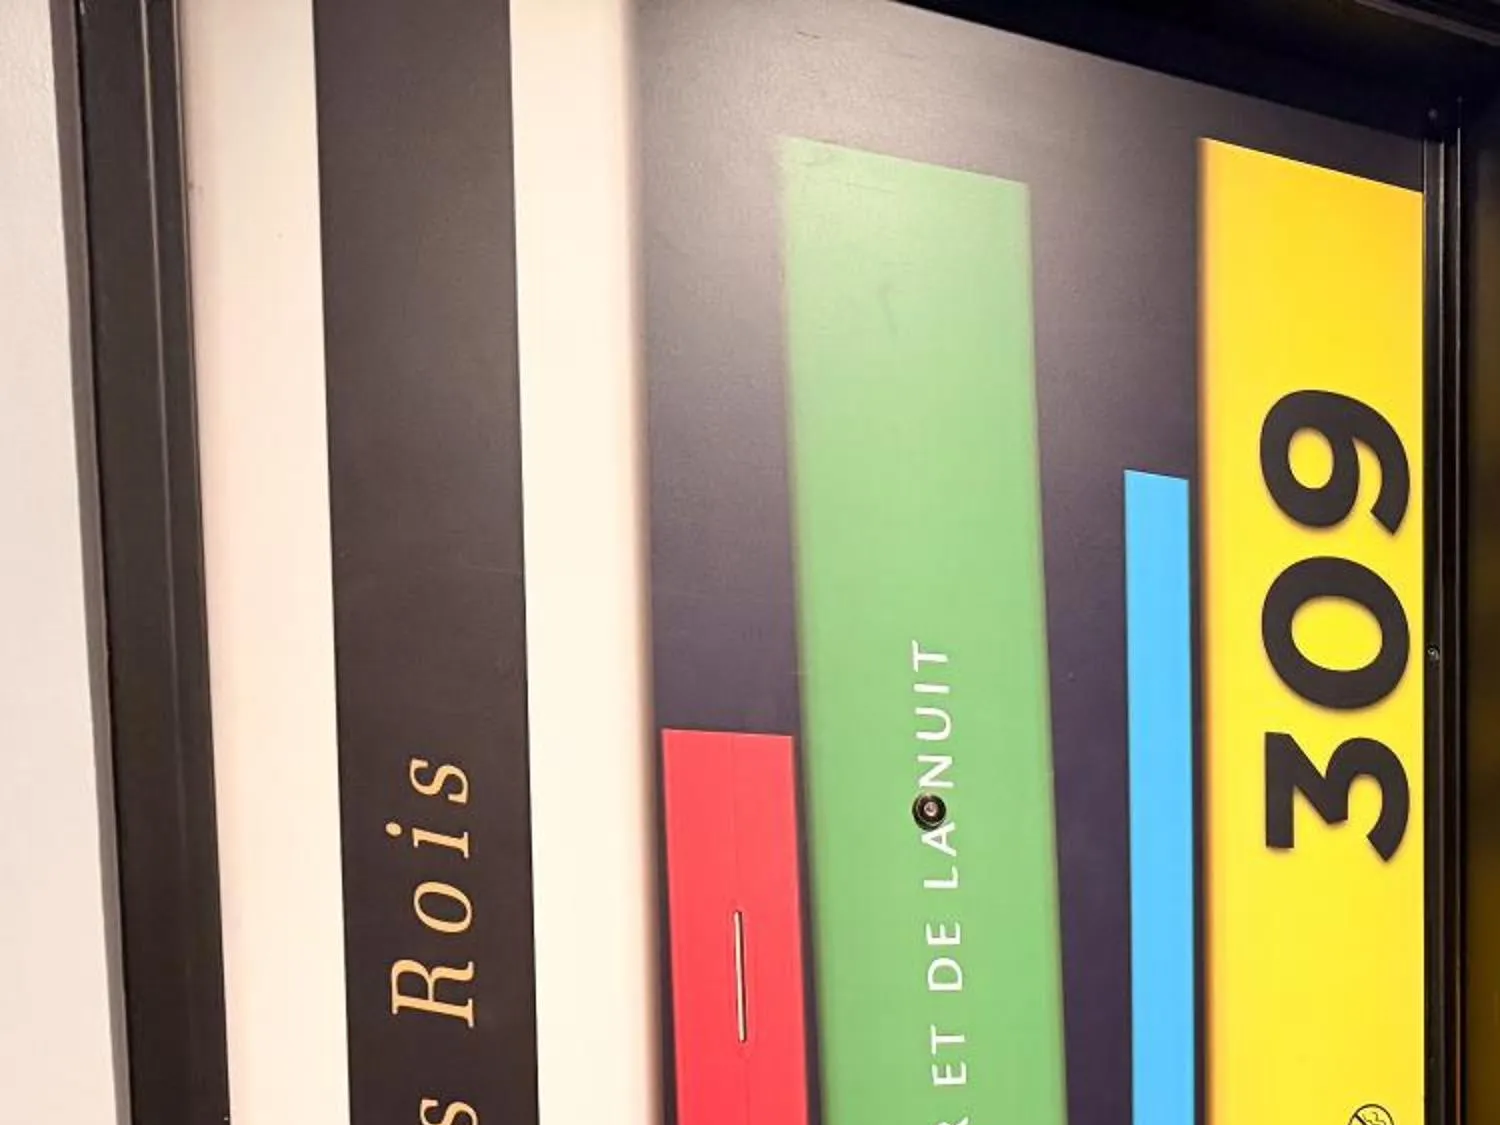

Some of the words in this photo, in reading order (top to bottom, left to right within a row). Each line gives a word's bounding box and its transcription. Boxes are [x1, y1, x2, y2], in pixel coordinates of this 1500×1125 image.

[1260, 389, 1411, 864] 309
[911, 638, 954, 788] NUIT
[385, 757, 476, 1030] Rois
[921, 822, 959, 889] LA
[926, 922, 964, 992] DE
[930, 1024, 968, 1087] ET
